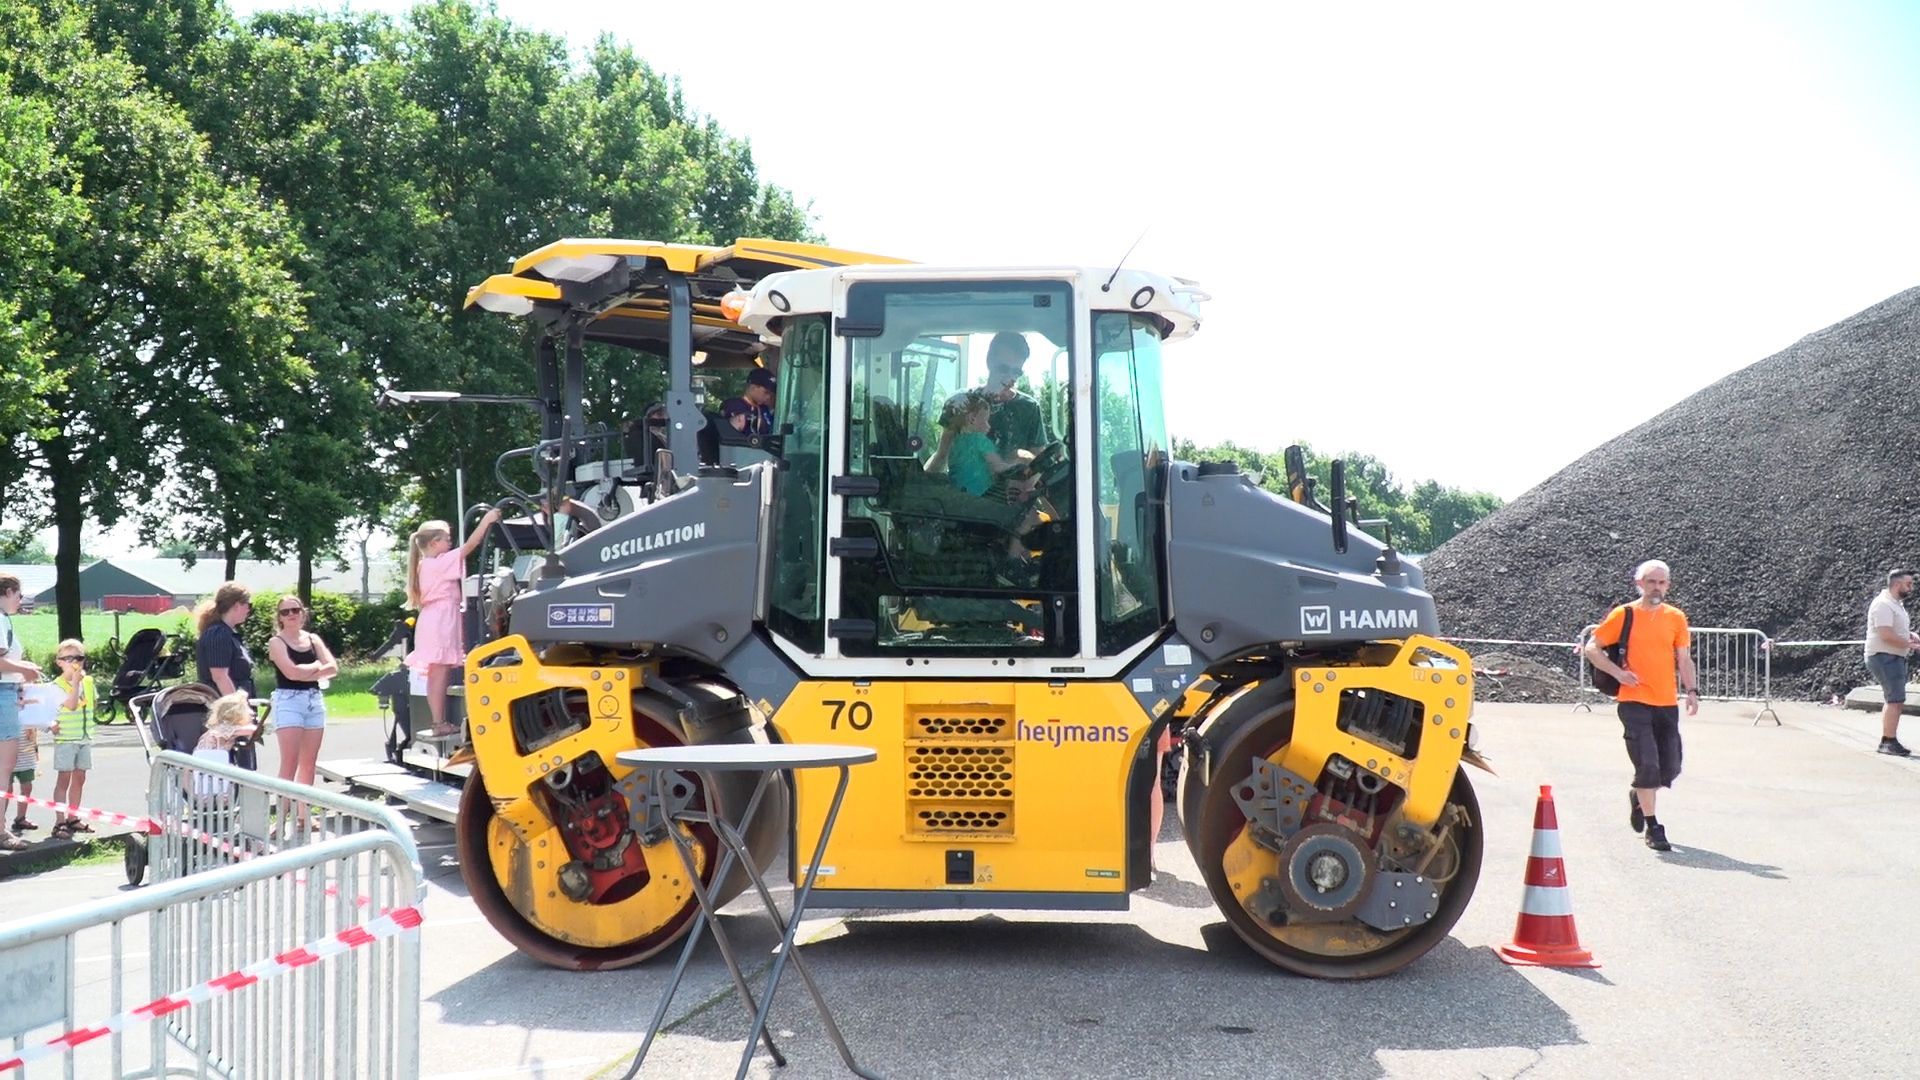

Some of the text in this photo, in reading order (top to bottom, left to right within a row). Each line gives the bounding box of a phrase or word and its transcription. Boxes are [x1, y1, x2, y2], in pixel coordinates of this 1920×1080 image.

[600, 522, 705, 562] OSCILLATION
[1339, 609, 1418, 629] HAMM
[822, 700, 873, 731] 70
[1017, 719, 1129, 748] heijmans
